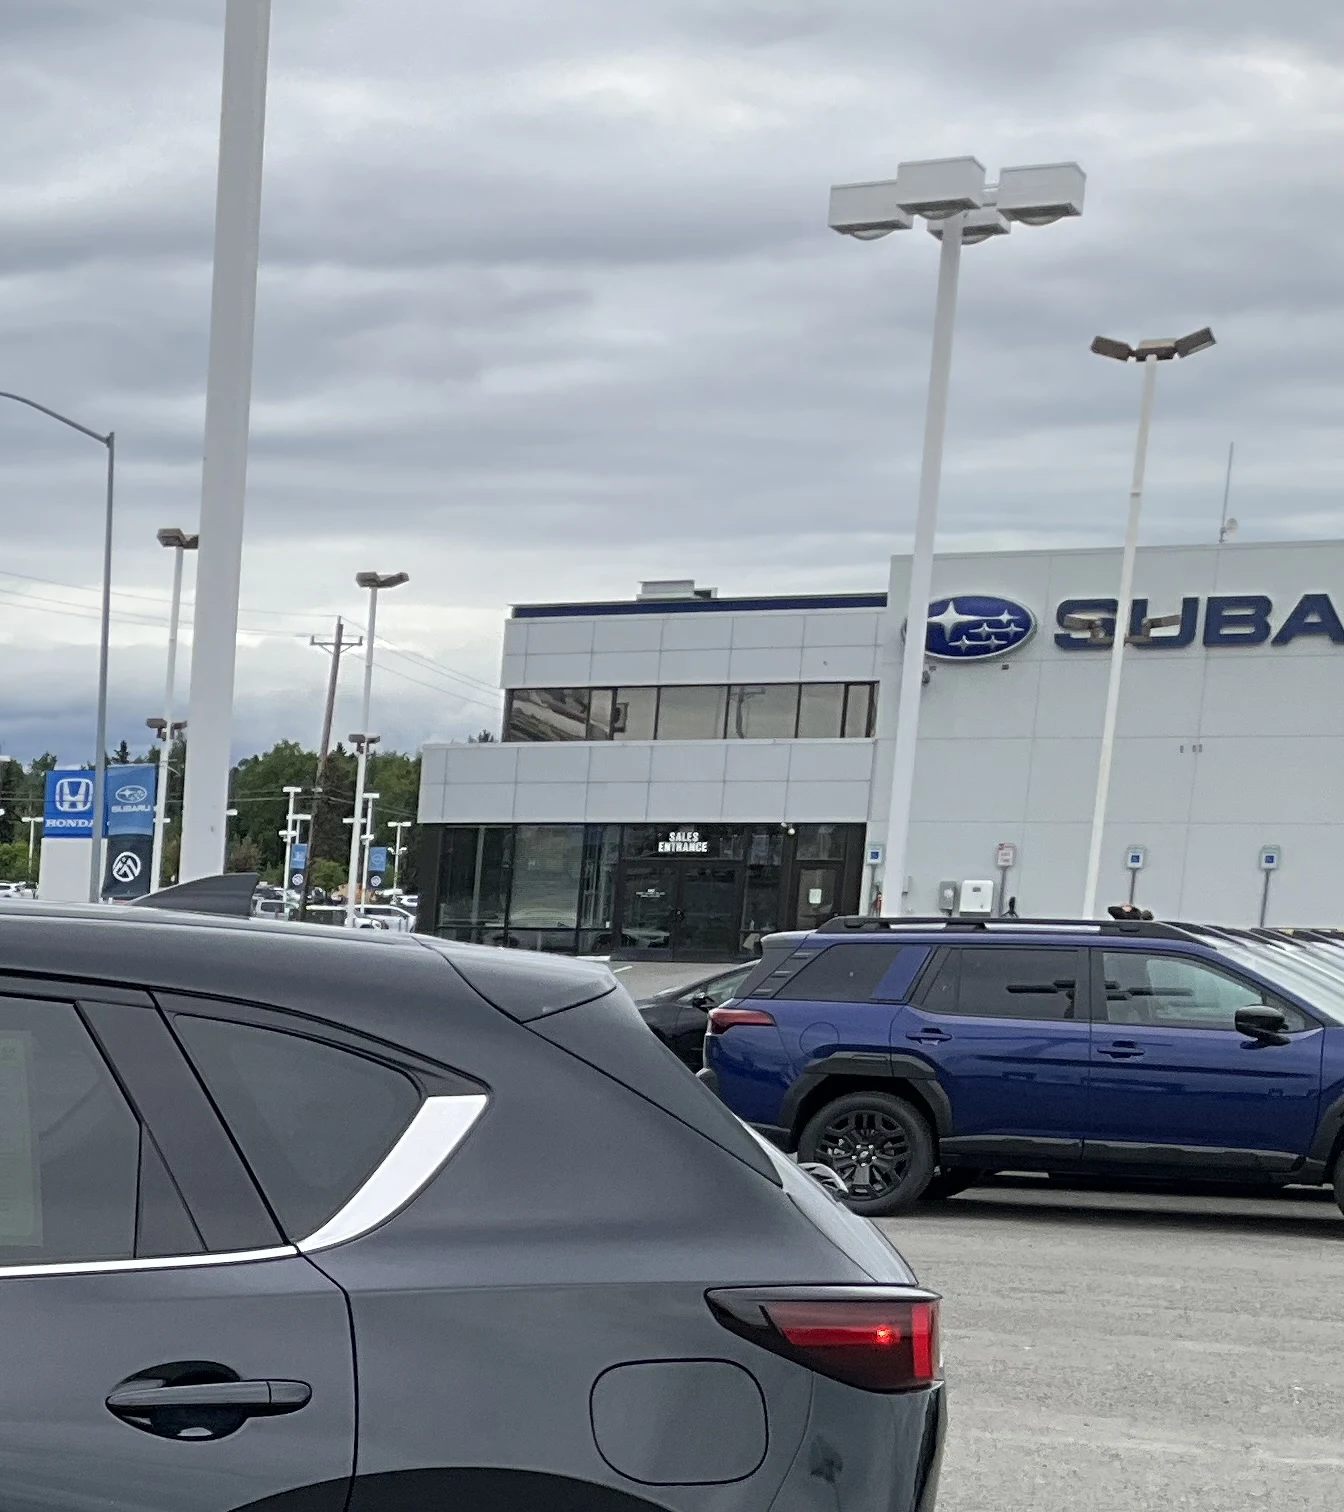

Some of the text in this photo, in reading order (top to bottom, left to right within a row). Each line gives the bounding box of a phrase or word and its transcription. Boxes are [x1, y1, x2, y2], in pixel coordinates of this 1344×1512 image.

[1054, 594, 1344, 650] SUBA
[111, 804, 151, 813] SUBARU
[668, 832, 699, 842] SALES
[658, 841, 708, 852] ENTRANCE
